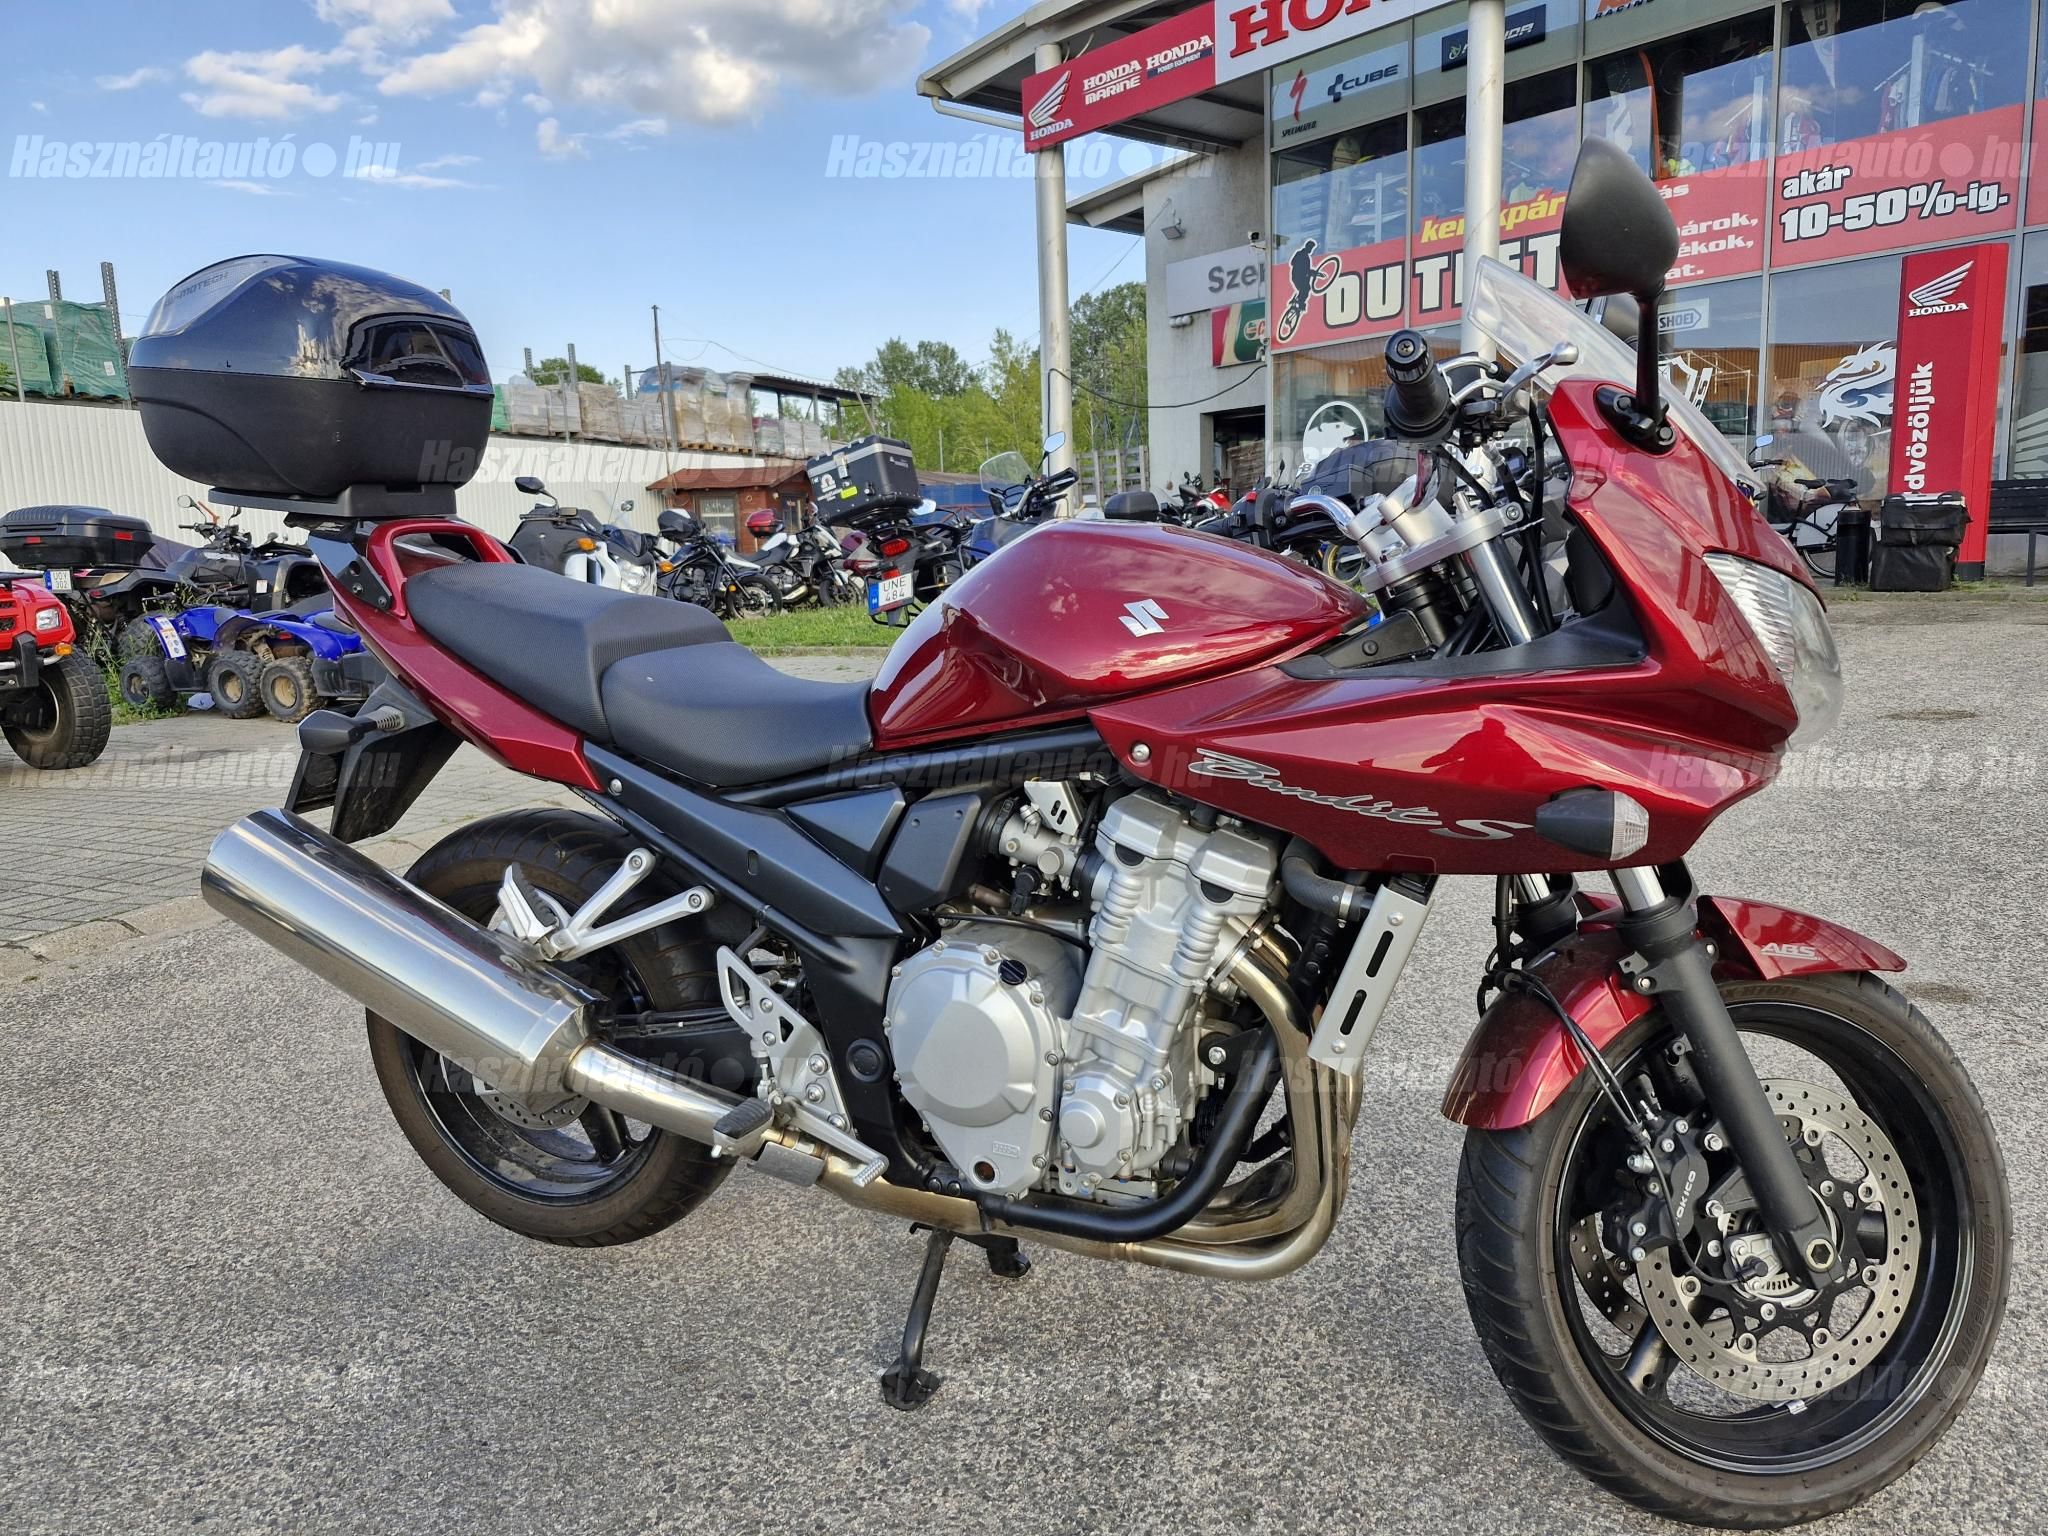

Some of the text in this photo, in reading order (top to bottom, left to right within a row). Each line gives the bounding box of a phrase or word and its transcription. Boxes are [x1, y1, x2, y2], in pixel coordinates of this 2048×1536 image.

[1146, 34, 1214, 69] HONDA
[1158, 52, 1201, 75] POWER EQUIPMENT
[1083, 60, 1142, 91] HONDA
[1342, 64, 1399, 90] CUBE
[1085, 76, 1142, 105] MARINE
[1030, 118, 1074, 140] HONDA
[1782, 164, 1852, 199] akár
[1677, 234, 1754, 258] ékok,
[1907, 302, 1969, 318] HONDA
[1659, 315, 1694, 329] SHOEI
[1904, 361, 1935, 493] dvözöljük
[883, 576, 907, 592] UNE
[885, 587, 905, 602] 484
[1429, 819, 1536, 841] S
[1761, 942, 1818, 958] ABS
